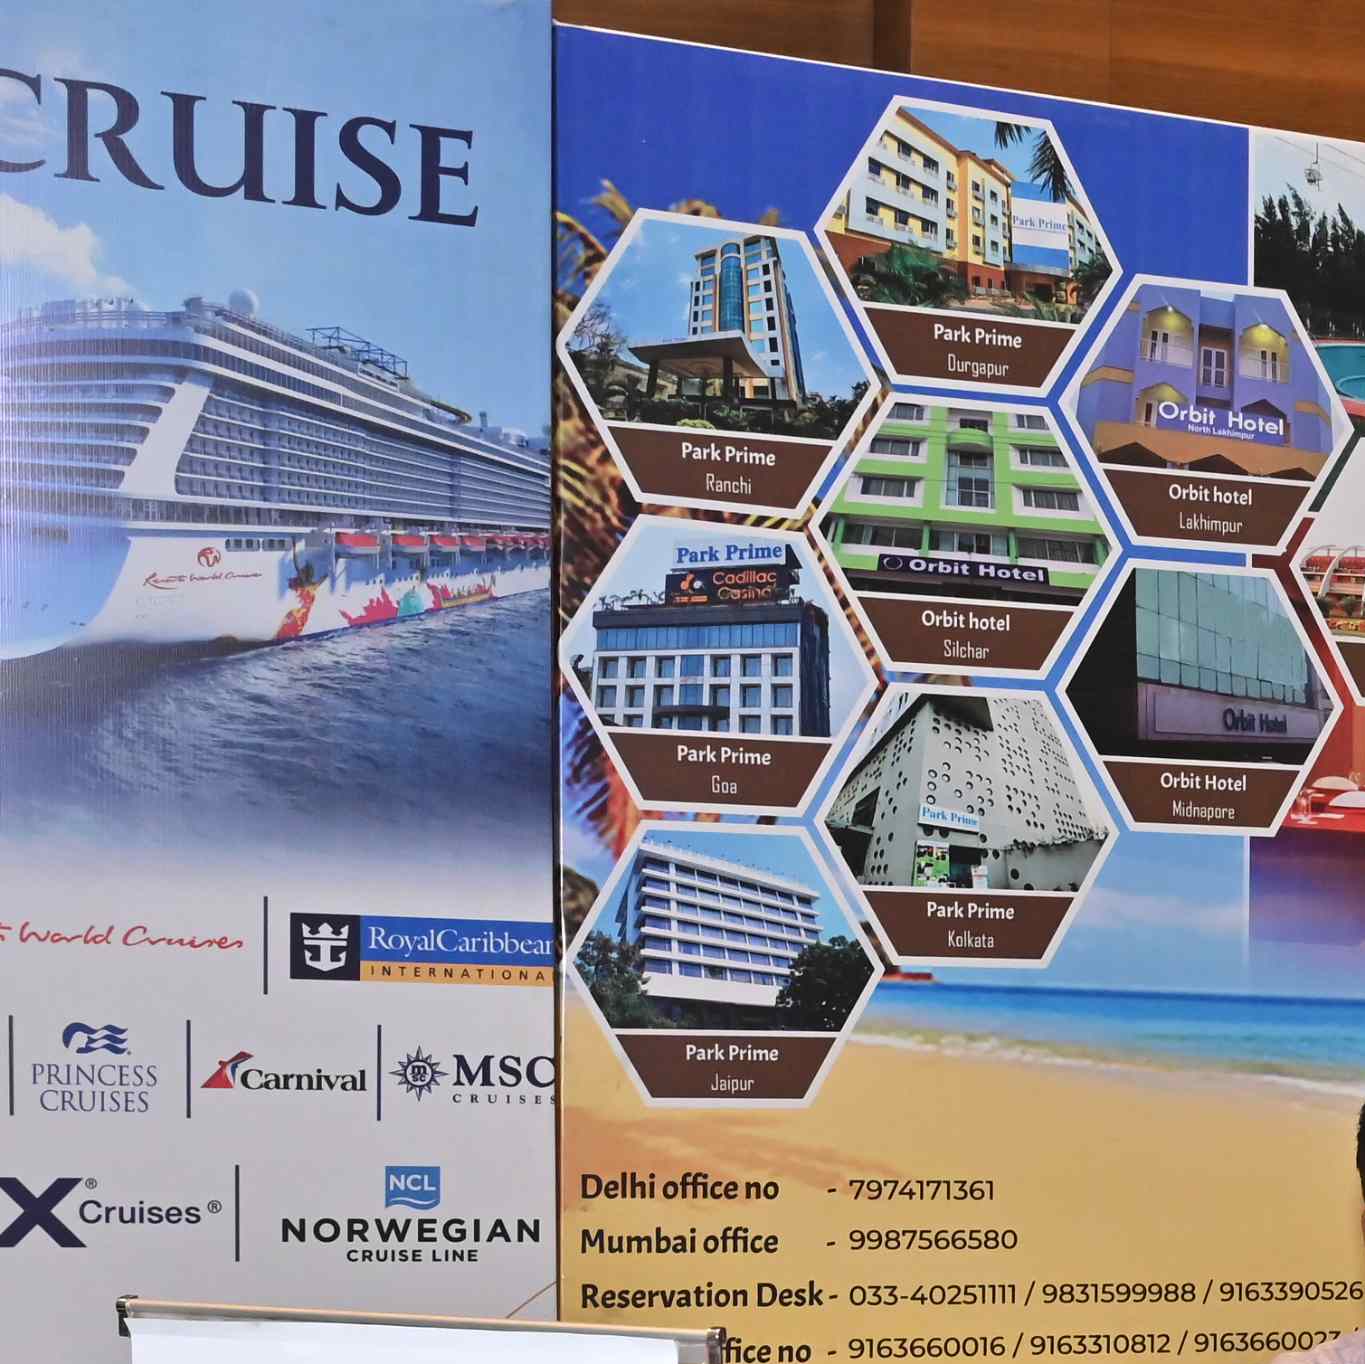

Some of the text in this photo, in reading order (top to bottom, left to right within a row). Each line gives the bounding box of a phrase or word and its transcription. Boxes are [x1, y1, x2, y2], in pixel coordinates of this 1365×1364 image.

[934, 323, 1023, 349] Park Prime
[947, 353, 1009, 377] Durgapur
[1158, 401, 1285, 436] Orbit Hotel
[1188, 423, 1256, 441] North Lakhimpur
[681, 442, 776, 466] Park Prime
[705, 473, 752, 495] Ranchi
[1168, 483, 1253, 505] Orbit hotel
[1179, 512, 1243, 535] Lakhimpur
[676, 543, 783, 563] Park Prime
[712, 569, 777, 585] Cadillac
[909, 558, 1045, 582] Orbit Hotel
[921, 610, 1010, 632] Orbit hotel
[943, 639, 989, 660] Silchar
[1223, 707, 1288, 733] Orbit Hotel
[677, 745, 772, 766] Park Prime
[711, 775, 737, 795] Goa
[1160, 772, 1247, 791] Orbit Hotel
[922, 807, 948, 822] Park
[1172, 800, 1235, 821] Midnapore
[927, 901, 1015, 920] Park Prime
[19, 922, 114, 945] World
[122, 926, 243, 948] Cruises
[947, 931, 994, 949] Kolkata
[371, 965, 551, 982] INTERNATIONA
[686, 1044, 779, 1063] Park Prime
[32, 1063, 157, 1087] PRINCESS
[241, 1068, 367, 1092] Carnival
[452, 1054, 555, 1088] MSC
[711, 1074, 755, 1094] Jaipur
[40, 1089, 149, 1113] CRUISES
[452, 1094, 556, 1105] CRUISES
[389, 1173, 436, 1191] NCL
[580, 1172, 655, 1200] Delhi
[662, 1172, 738, 1200] office
[745, 1180, 780, 1200] no
[848, 1179, 995, 1201] 7974171361
[281, 1217, 541, 1243] NORWEGIAN
[580, 1227, 696, 1254] Mumbai
[703, 1226, 779, 1254] office
[848, 1228, 1018, 1251] 9987566580
[346, 1248, 478, 1263] CRUISE LINE
[580, 1281, 748, 1309] Reservation
[756, 1280, 824, 1308] Desk
[848, 1283, 1017, 1307] 033-40251111
[1041, 1281, 1197, 1305] 9831599988
[1218, 1280, 1364, 1302] 9163390526
[722, 1336, 772, 1364] fice
[777, 1344, 811, 1363] no
[848, 1335, 1006, 1359] 9163660016
[1029, 1333, 1171, 1357] 9163310812
